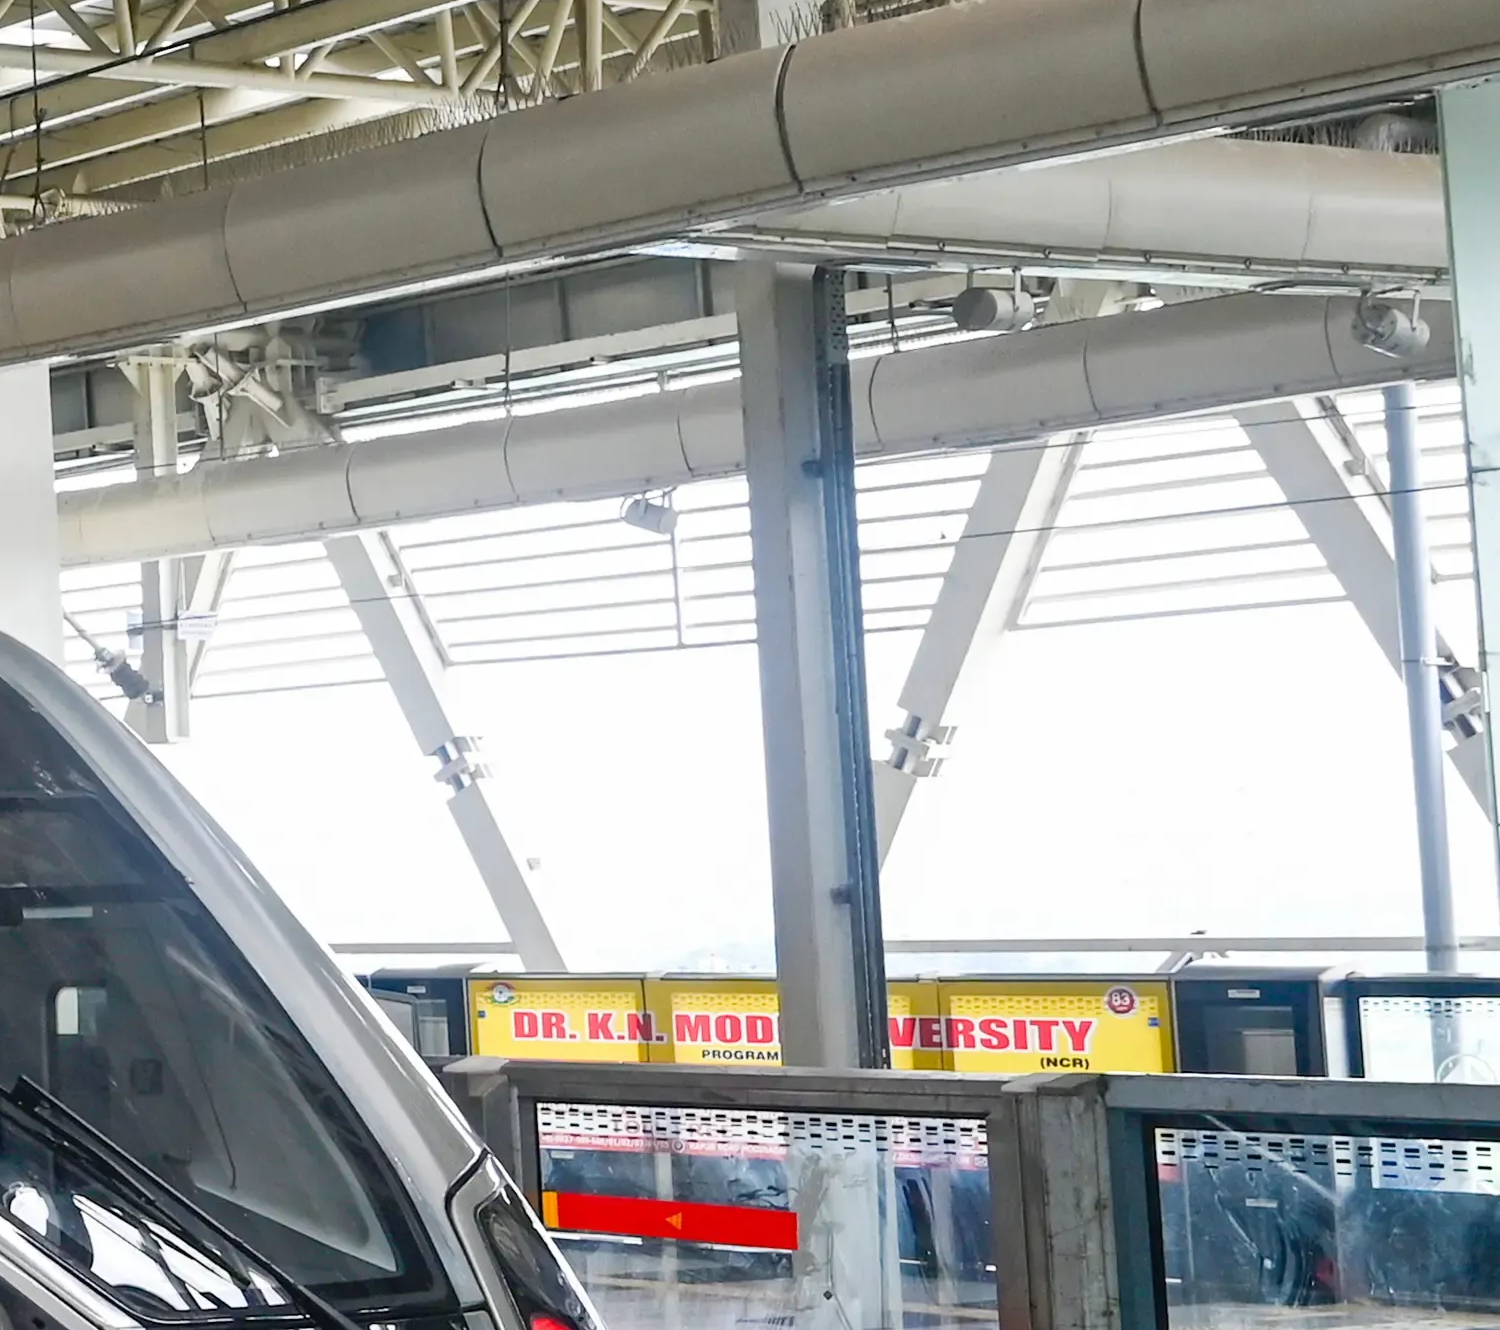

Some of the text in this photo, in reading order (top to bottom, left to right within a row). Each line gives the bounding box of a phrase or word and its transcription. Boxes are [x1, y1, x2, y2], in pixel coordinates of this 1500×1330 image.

[1111, 992, 1131, 1006] 83
[513, 1011, 1092, 1052] DR. K.N. MOD VERSITY
[1039, 1056, 1090, 1071] (NCR)
